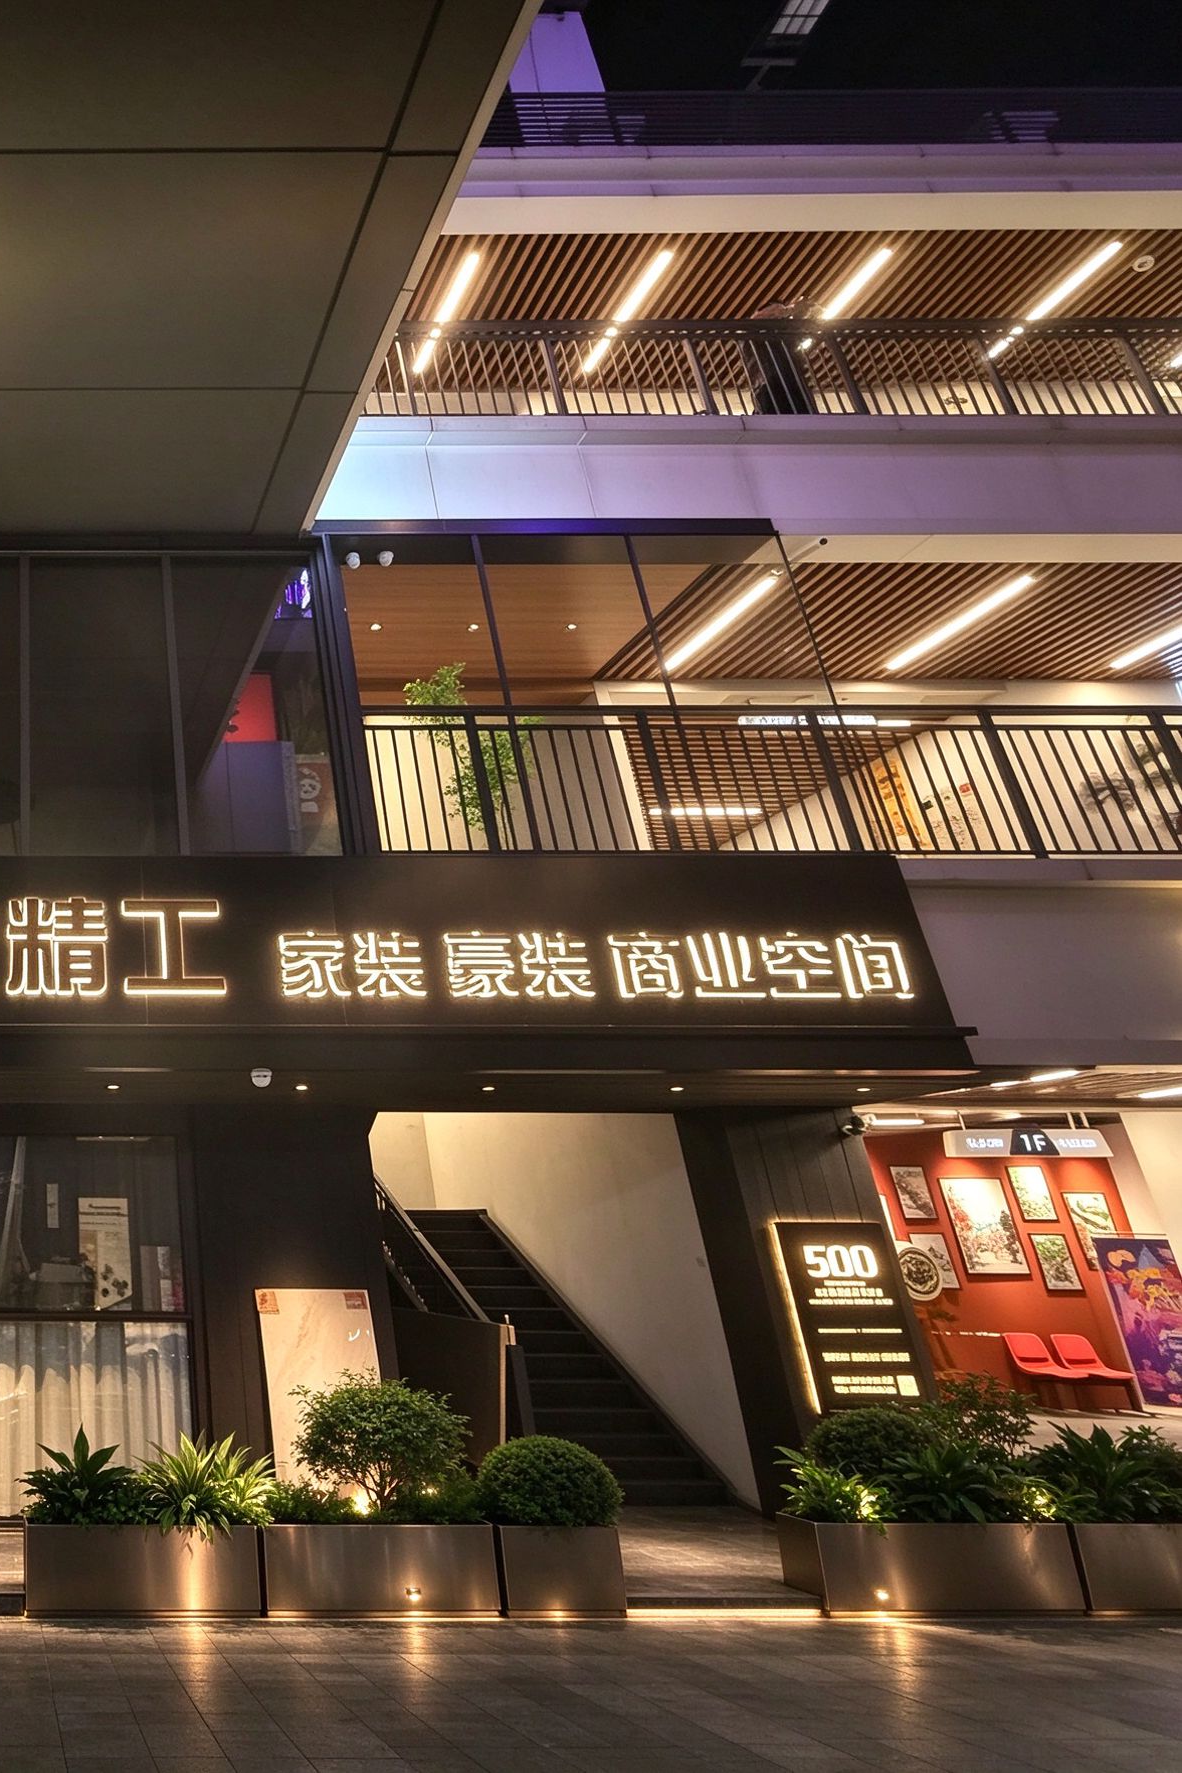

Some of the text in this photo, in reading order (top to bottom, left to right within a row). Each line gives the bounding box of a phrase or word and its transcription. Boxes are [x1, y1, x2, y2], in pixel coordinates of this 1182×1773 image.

[277, 930, 916, 1000] 家装 豪装 商业空间
[1018, 1133, 1047, 1152] 1F
[801, 1244, 879, 1279] 500
